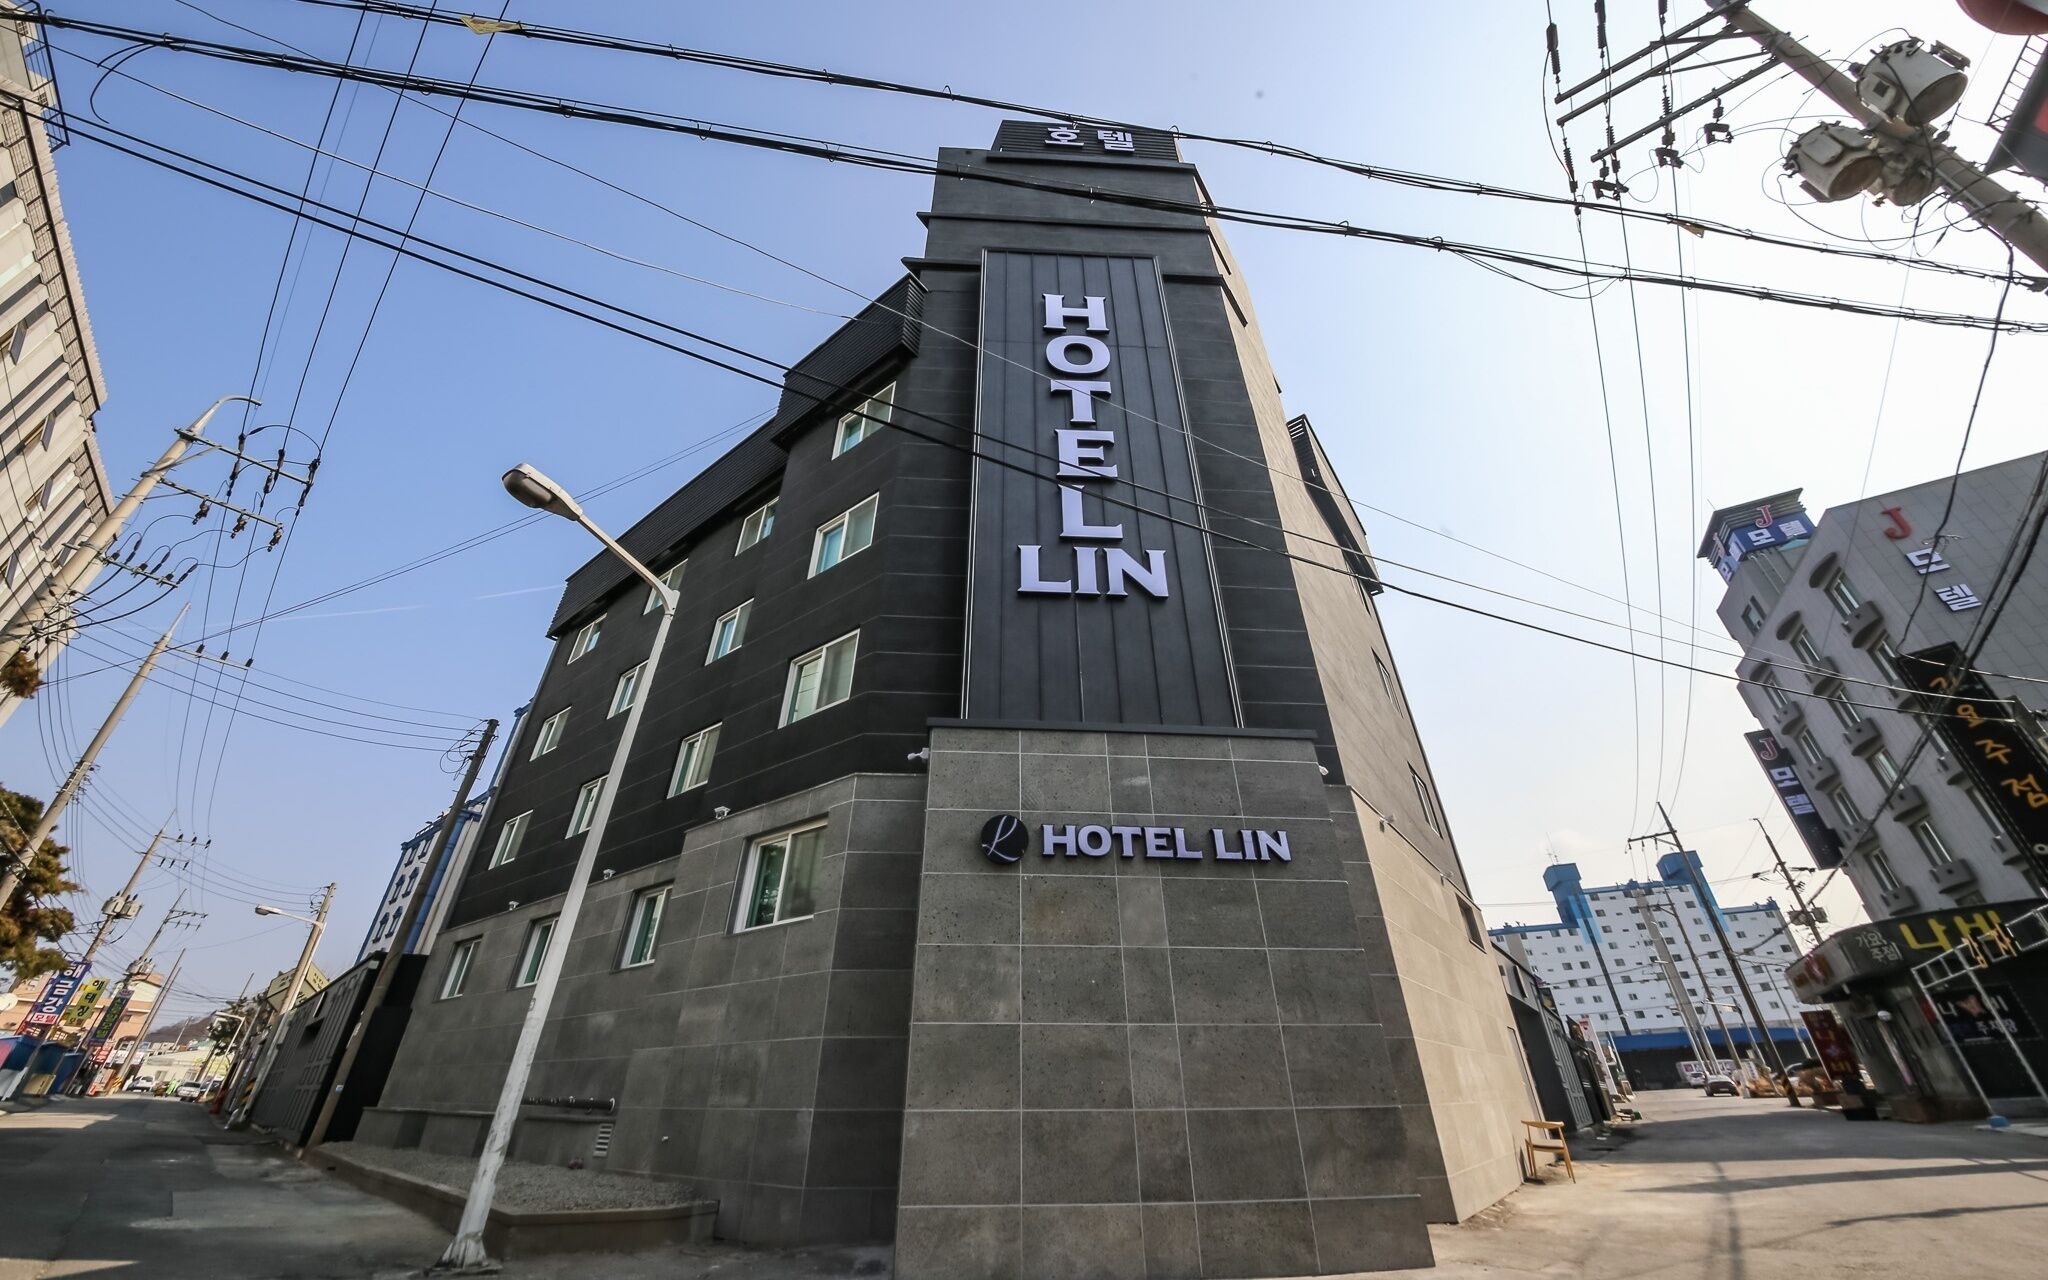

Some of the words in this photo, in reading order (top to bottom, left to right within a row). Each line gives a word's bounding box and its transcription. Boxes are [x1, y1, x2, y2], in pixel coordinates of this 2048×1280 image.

[1044, 126, 1136, 152] 호텔
[1042, 293, 1124, 540] HOTEL
[1755, 504, 1774, 528] J
[1881, 506, 1912, 540] J
[1017, 544, 1169, 599] LIN
[1905, 547, 1982, 612] 모텔
[1759, 737, 1779, 761] J
[1770, 766, 1815, 815] 모텔
[1041, 823, 1204, 860] HOTEL
[1211, 827, 1292, 862] LIN
